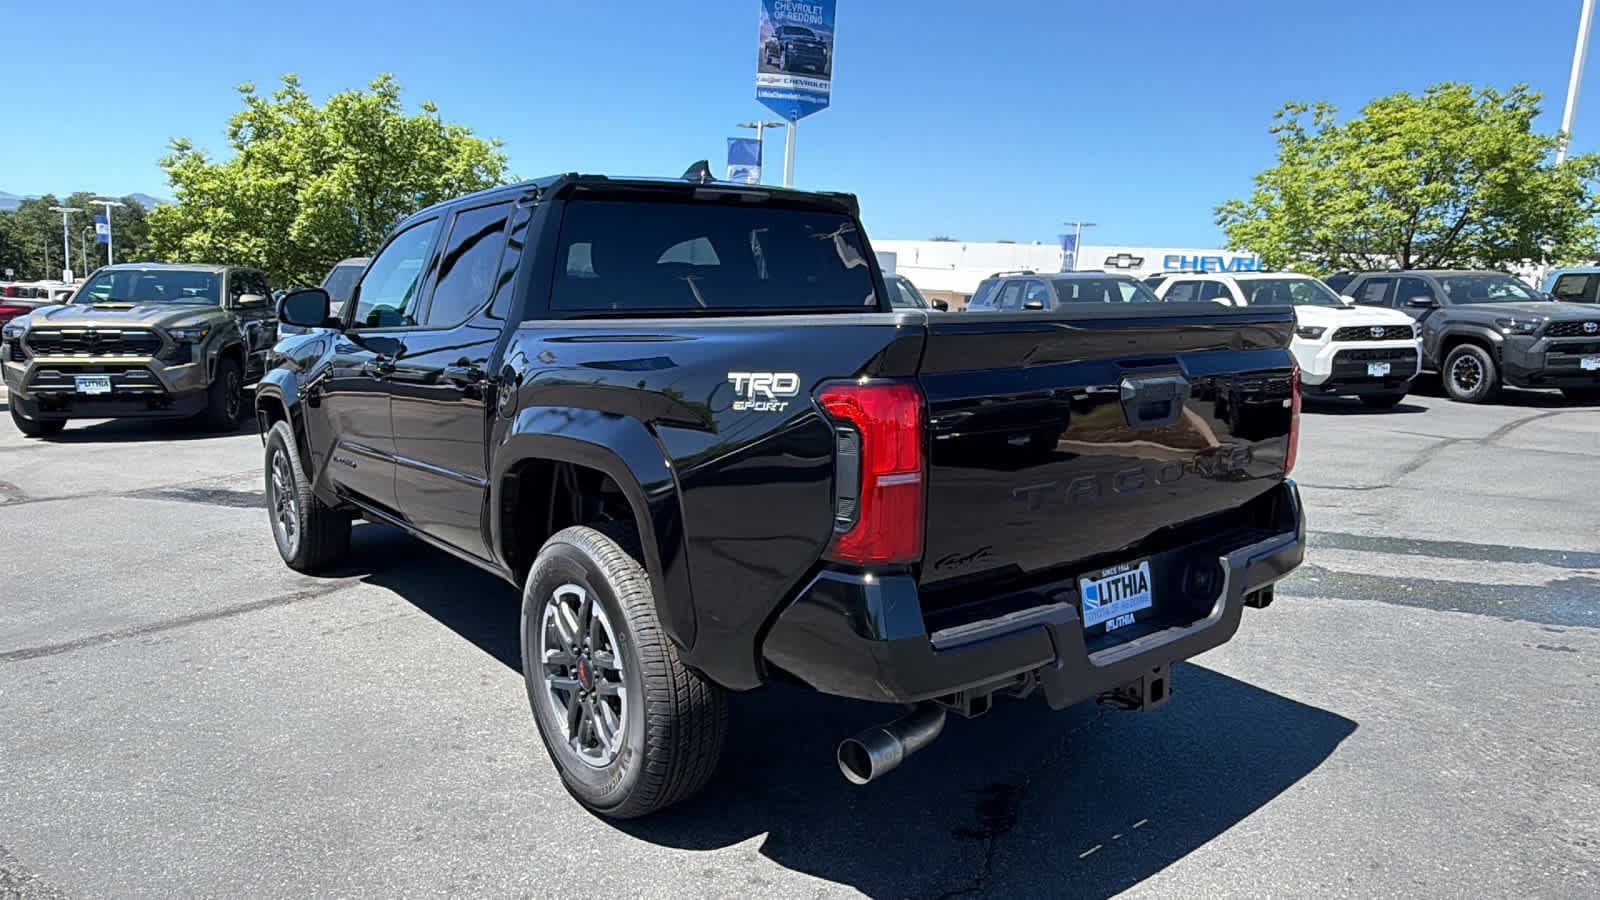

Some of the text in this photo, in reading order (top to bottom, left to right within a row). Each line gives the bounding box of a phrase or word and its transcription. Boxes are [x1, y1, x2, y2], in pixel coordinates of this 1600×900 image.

[774, 1, 824, 15] CHEVROLET
[774, 11, 823, 25] OF REDDING
[783, 78, 829, 89] CHEVROLET
[727, 371, 800, 400] TRD
[732, 401, 789, 412] SPORT
[1098, 571, 1147, 607] LITHIA
